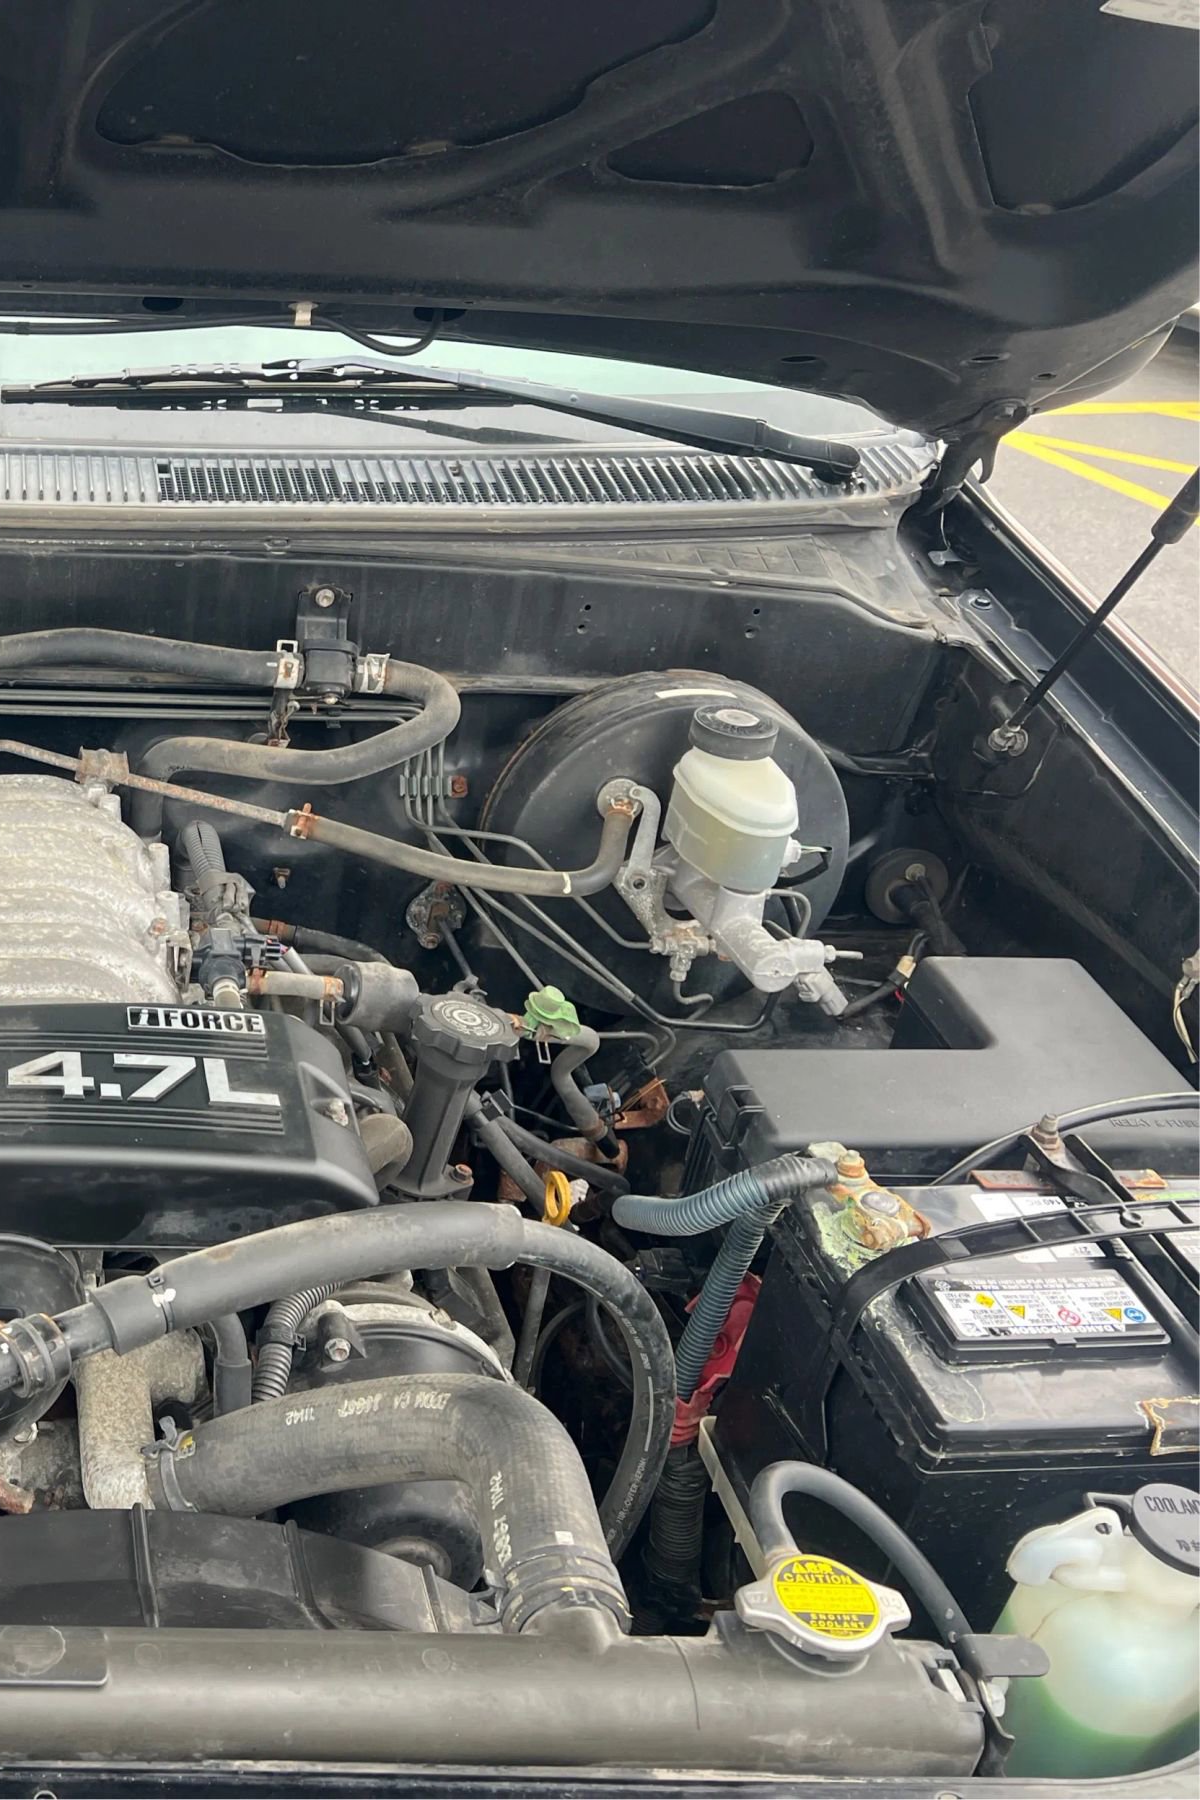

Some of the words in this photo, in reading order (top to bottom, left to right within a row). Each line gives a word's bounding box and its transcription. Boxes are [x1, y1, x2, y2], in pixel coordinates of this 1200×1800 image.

[7, 1051, 281, 1107] 4.7L
[783, 1572, 853, 1585] CAUTION
[809, 1613, 860, 1622] ENGINE
[809, 1620, 866, 1630] COOLANT
